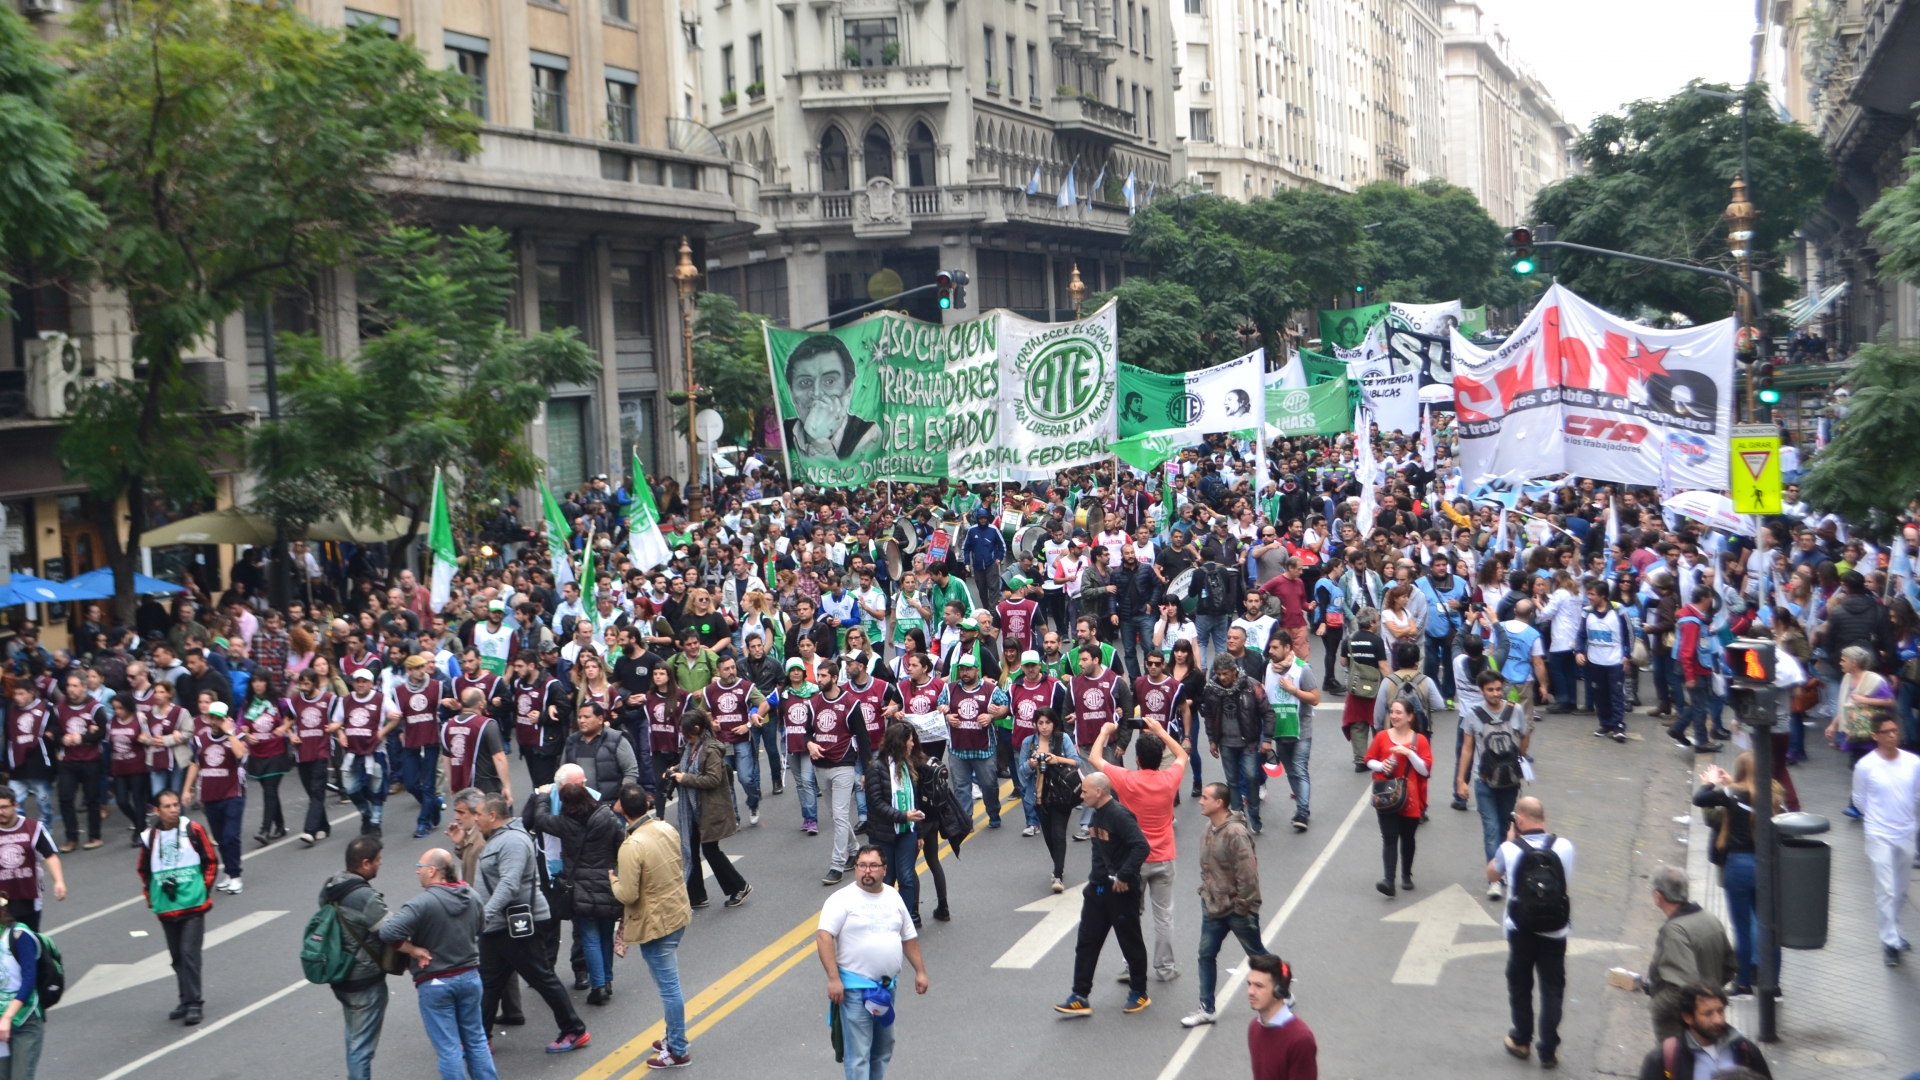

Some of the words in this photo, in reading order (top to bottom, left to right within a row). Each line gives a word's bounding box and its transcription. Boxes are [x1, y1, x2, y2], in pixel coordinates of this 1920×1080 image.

[878, 314, 998, 362] ASOCIACION
[1014, 326, 1070, 371] FORTALECER
[1246, 354, 1255, 363] Y
[878, 358, 999, 407] TRABAJADORES
[1032, 345, 1094, 414] ATE
[1169, 377, 1200, 387] CULTO
[1013, 398, 1029, 426] PARA
[1026, 419, 1071, 437] LIBERAR
[1073, 418, 1088, 431] LA
[1087, 381, 1115, 424] NACION
[1171, 395, 1199, 421] ATE
[1612, 397, 1629, 410] el
[882, 412, 918, 451] DEL
[925, 408, 998, 452] ESTADO
[1275, 412, 1316, 431] INAES
[1564, 414, 1649, 445] CTA
[1027, 435, 1113, 467] FEDERAL
[1583, 438, 1642, 454] trabajadores
[1748, 441, 1771, 449] GIRAR
